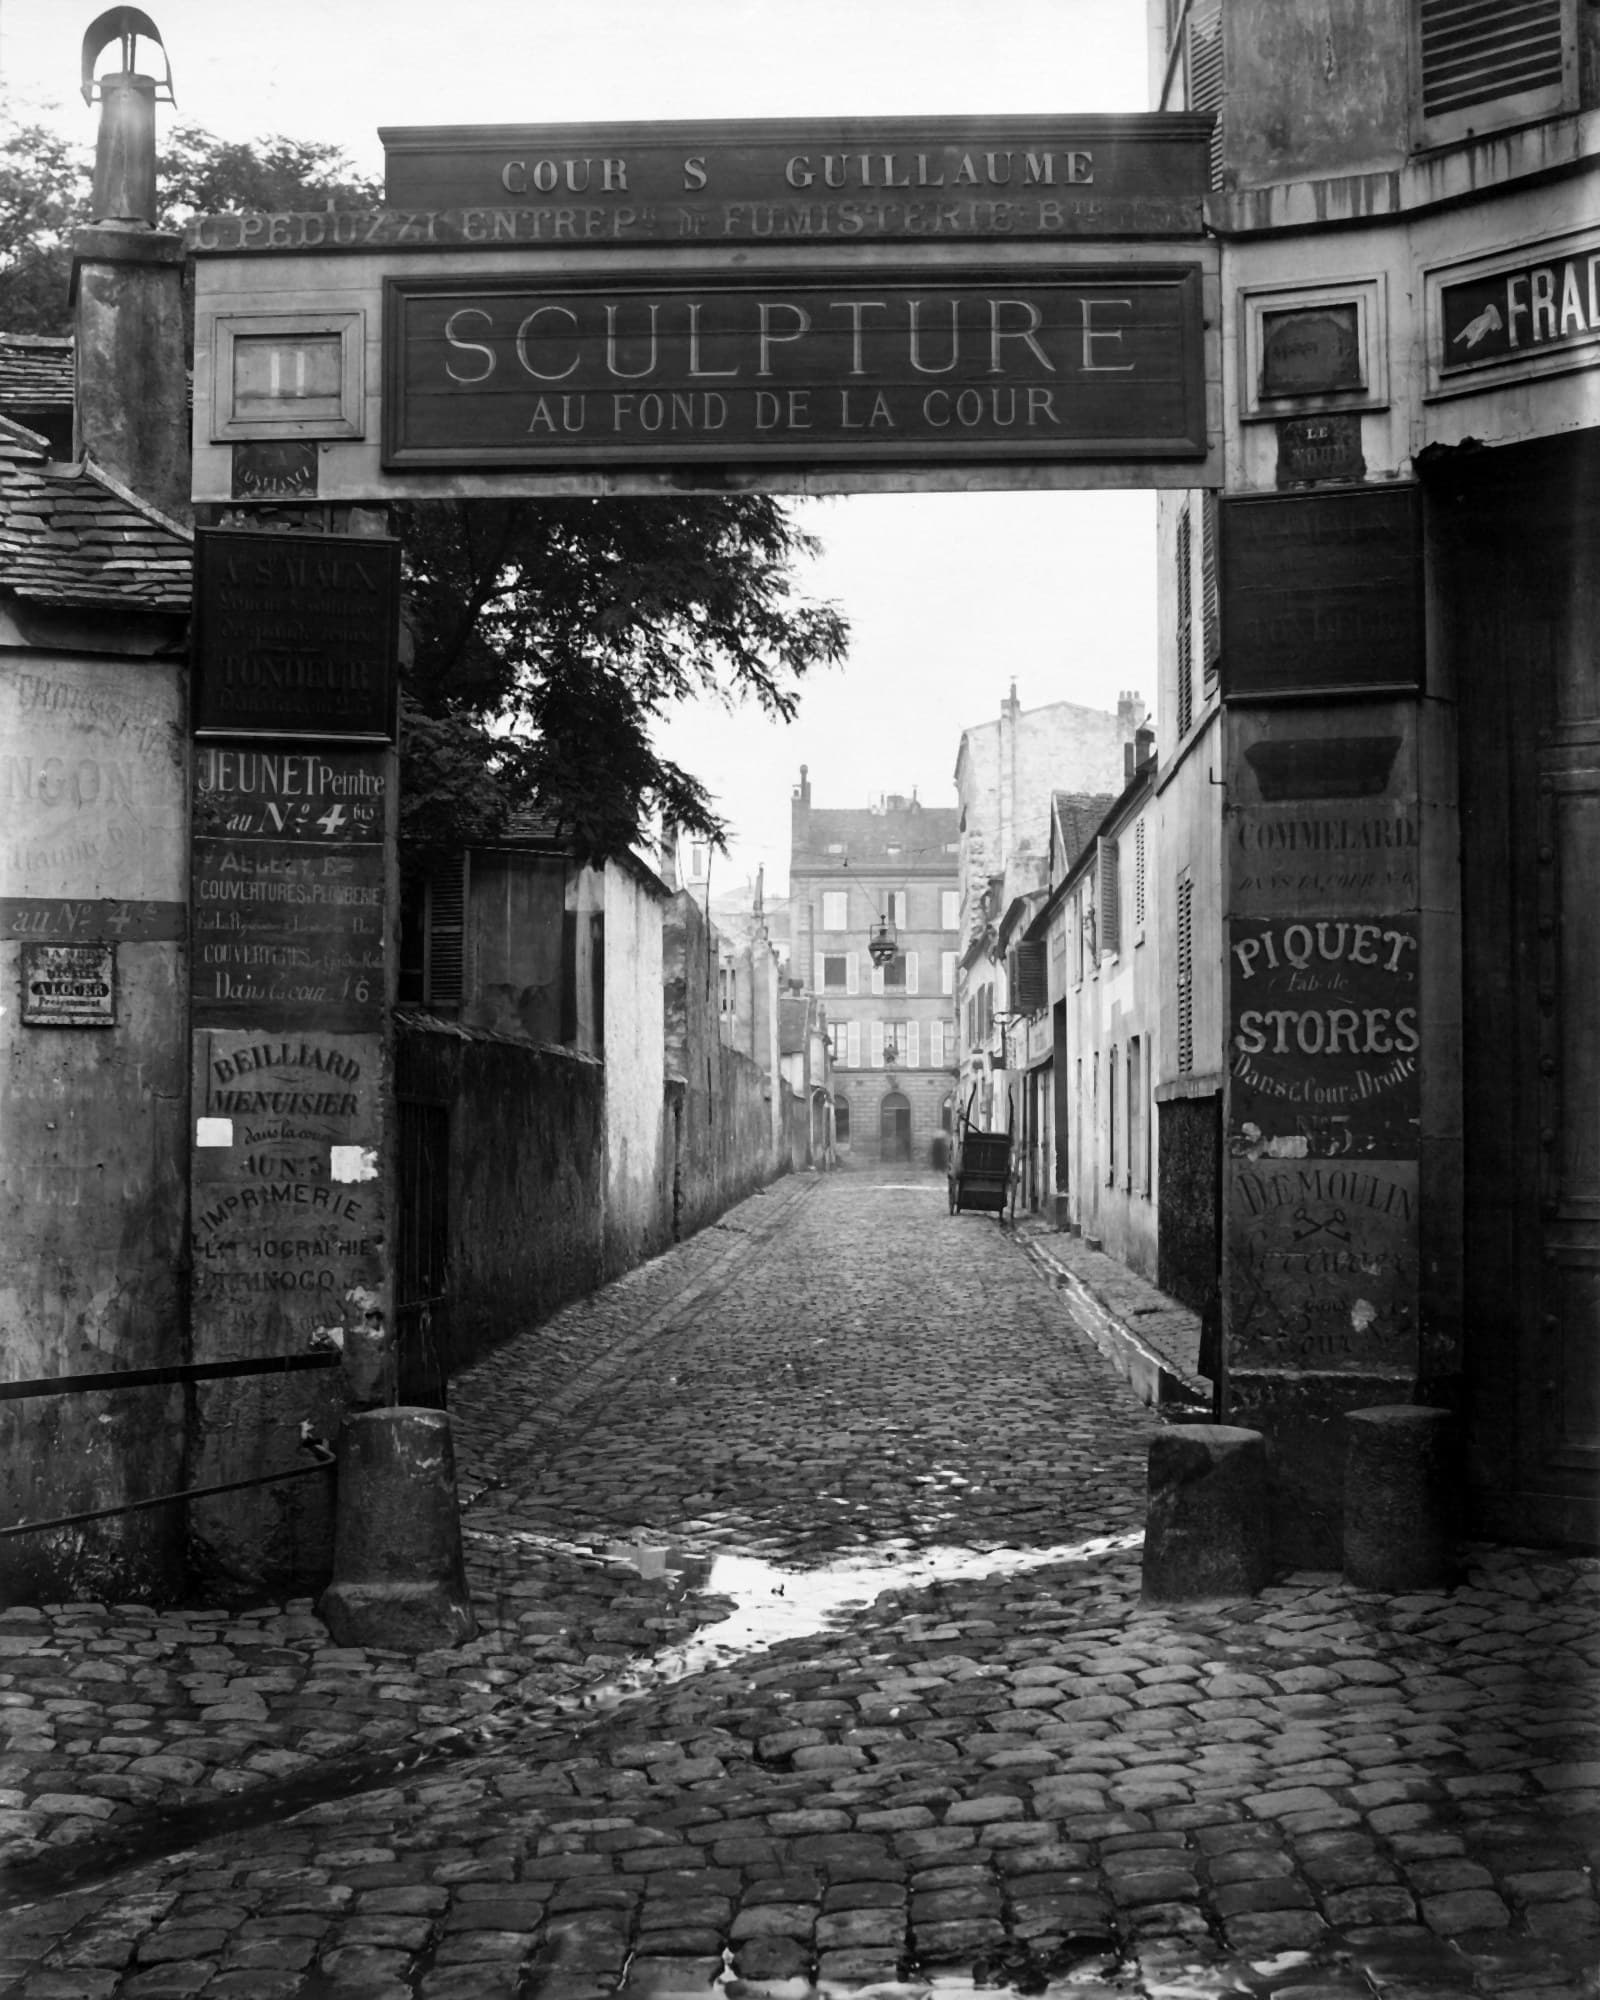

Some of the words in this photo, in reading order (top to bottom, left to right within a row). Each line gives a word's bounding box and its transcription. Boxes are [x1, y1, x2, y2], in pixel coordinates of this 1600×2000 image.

[502, 157, 629, 194] COUR
[785, 151, 1094, 189] GUILLAUME
[721, 200, 1013, 236] FUMISTERIE
[444, 298, 1136, 383] SCULPTURE
[528, 396, 586, 433] AU
[613, 393, 728, 432] FOND
[756, 391, 812, 430] DE
[841, 390, 895, 429] LA
[923, 388, 1061, 427] COUR
[198, 750, 320, 796] JEUNET
[320, 766, 385, 797] Peintre
[226, 813, 253, 832] au
[1232, 922, 1416, 979] PIQUET
[1234, 1007, 1420, 1054] STORES
[213, 1042, 361, 1085] BEILLIARD
[209, 1089, 359, 1117] MENUISIER
[199, 1182, 363, 1233] IMPRIMERIE
[1237, 1169, 1411, 1222] DEMOULIN
